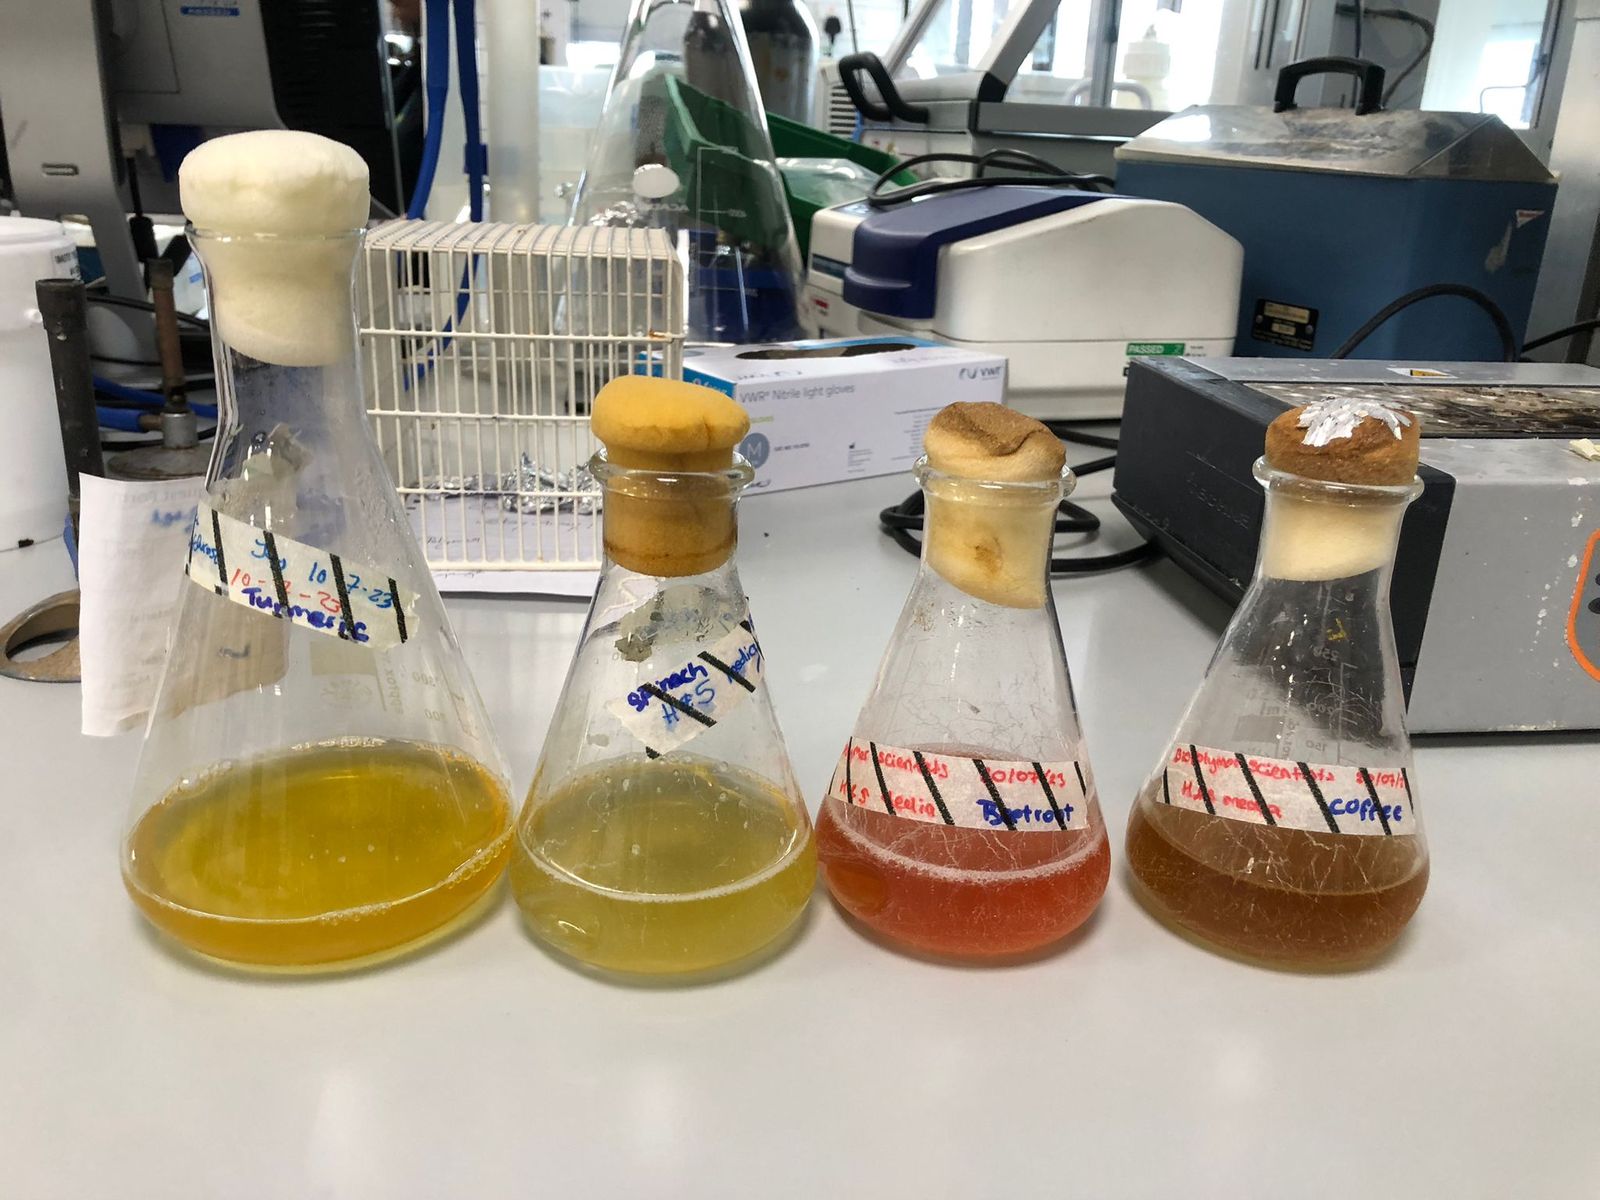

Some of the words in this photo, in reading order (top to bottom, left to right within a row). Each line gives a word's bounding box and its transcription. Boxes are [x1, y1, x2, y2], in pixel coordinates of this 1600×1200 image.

[1127, 344, 1164, 354] PASSED
[772, 388, 800, 400] Nitrile
[803, 386, 824, 399] light
[826, 384, 855, 398] gloves
[747, 442, 762, 459] M
